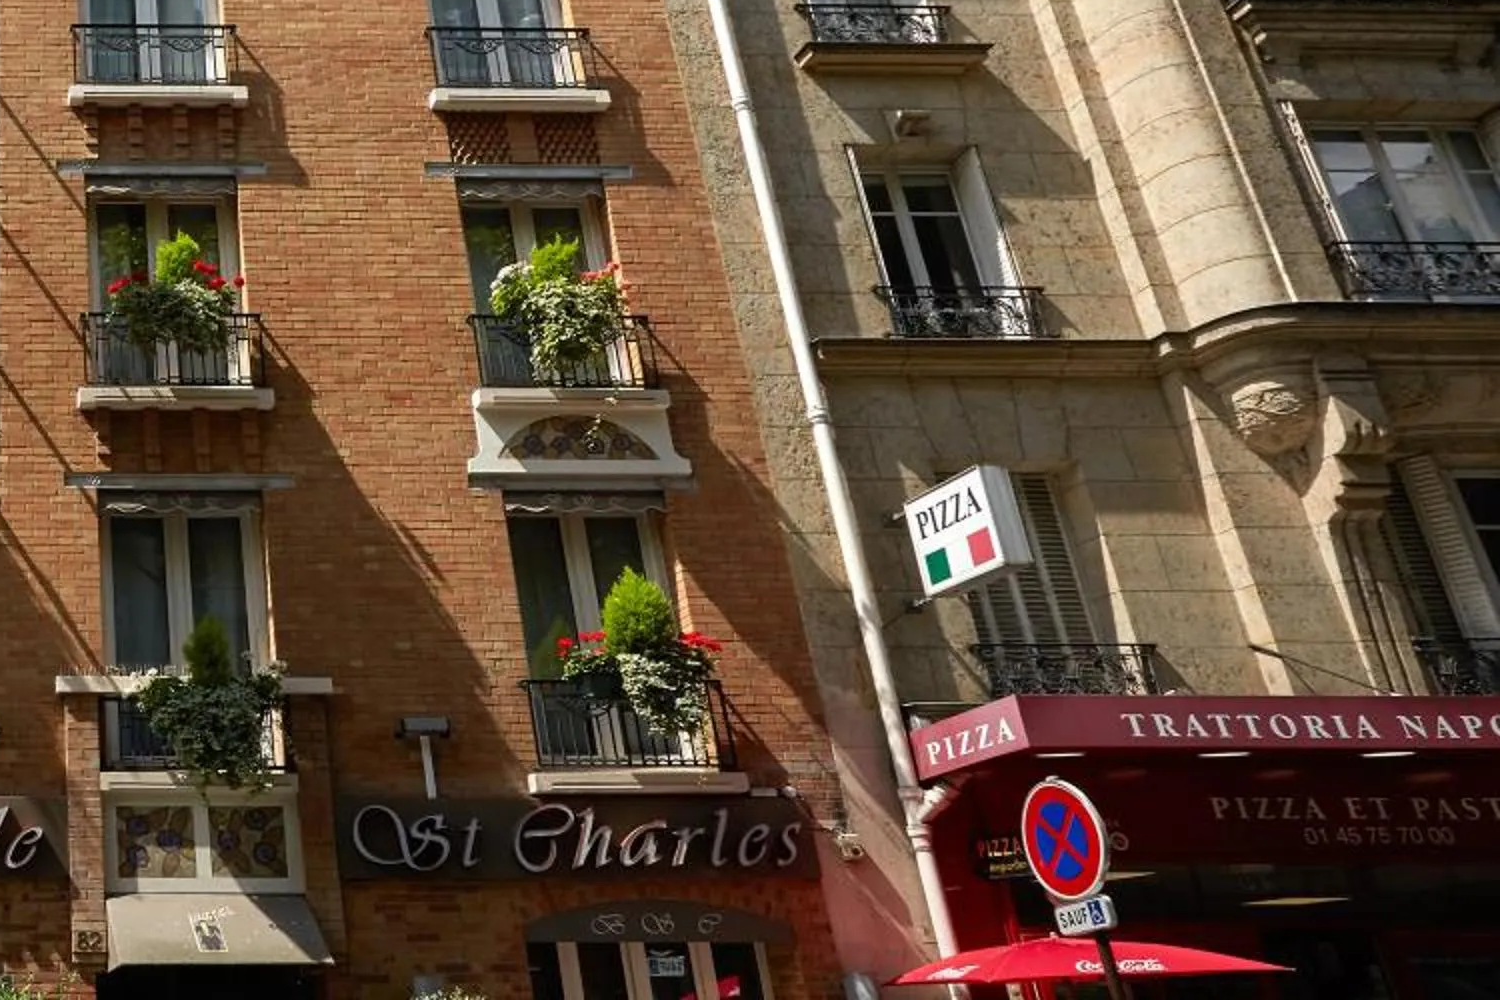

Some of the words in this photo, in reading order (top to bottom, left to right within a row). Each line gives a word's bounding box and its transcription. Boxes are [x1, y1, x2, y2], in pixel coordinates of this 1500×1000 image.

[916, 487, 982, 540] PIZZA
[1121, 712, 1381, 740] TRATTORIA
[925, 719, 1016, 766] PIZZA
[1210, 796, 1327, 821] PIZZA
[1343, 796, 1391, 821] ET
[353, 804, 482, 871] St
[513, 803, 804, 873] Charles
[1366, 827, 1392, 846] 75
[1396, 827, 1424, 846] 70
[1060, 908, 1088, 929] SAUF
[77, 931, 104, 952] 82
